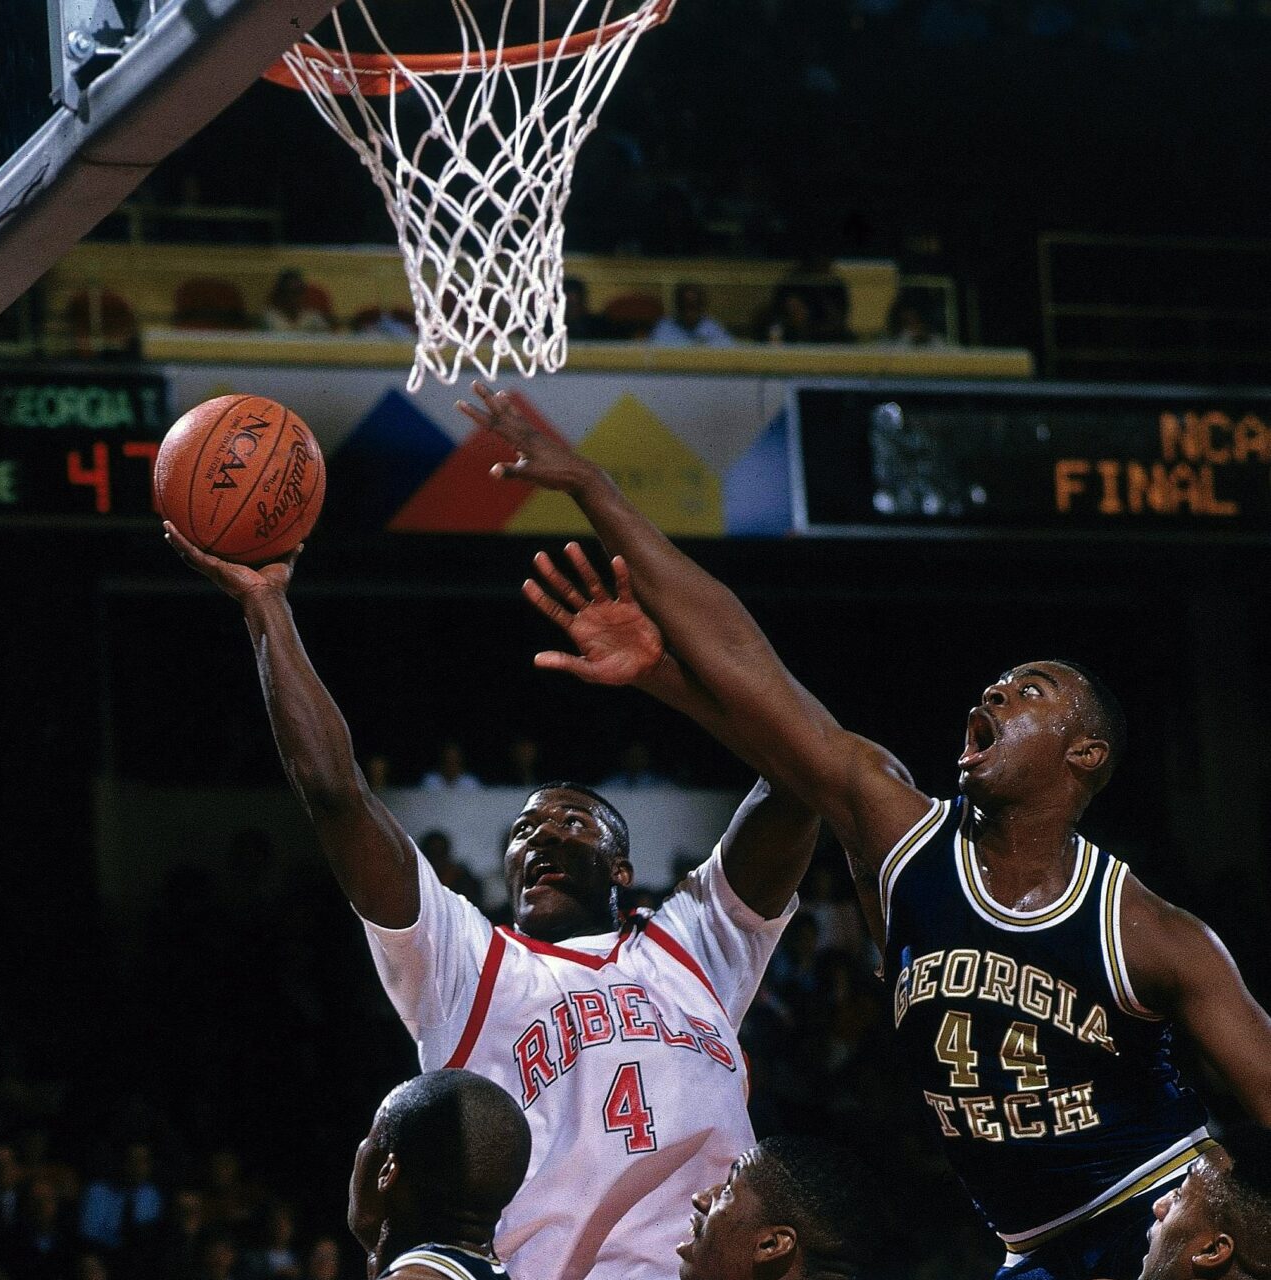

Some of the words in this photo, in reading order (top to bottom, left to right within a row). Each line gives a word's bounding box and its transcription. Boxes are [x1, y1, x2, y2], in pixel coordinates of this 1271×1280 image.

[211, 413, 270, 494] NCAA
[1055, 458, 1238, 515] FINAL
[894, 948, 1120, 1056] GEORGIA
[513, 983, 737, 1110] REBELS
[934, 1010, 1049, 1091] 44
[602, 1061, 657, 1155] 4
[923, 1080, 1100, 1142] TECH
